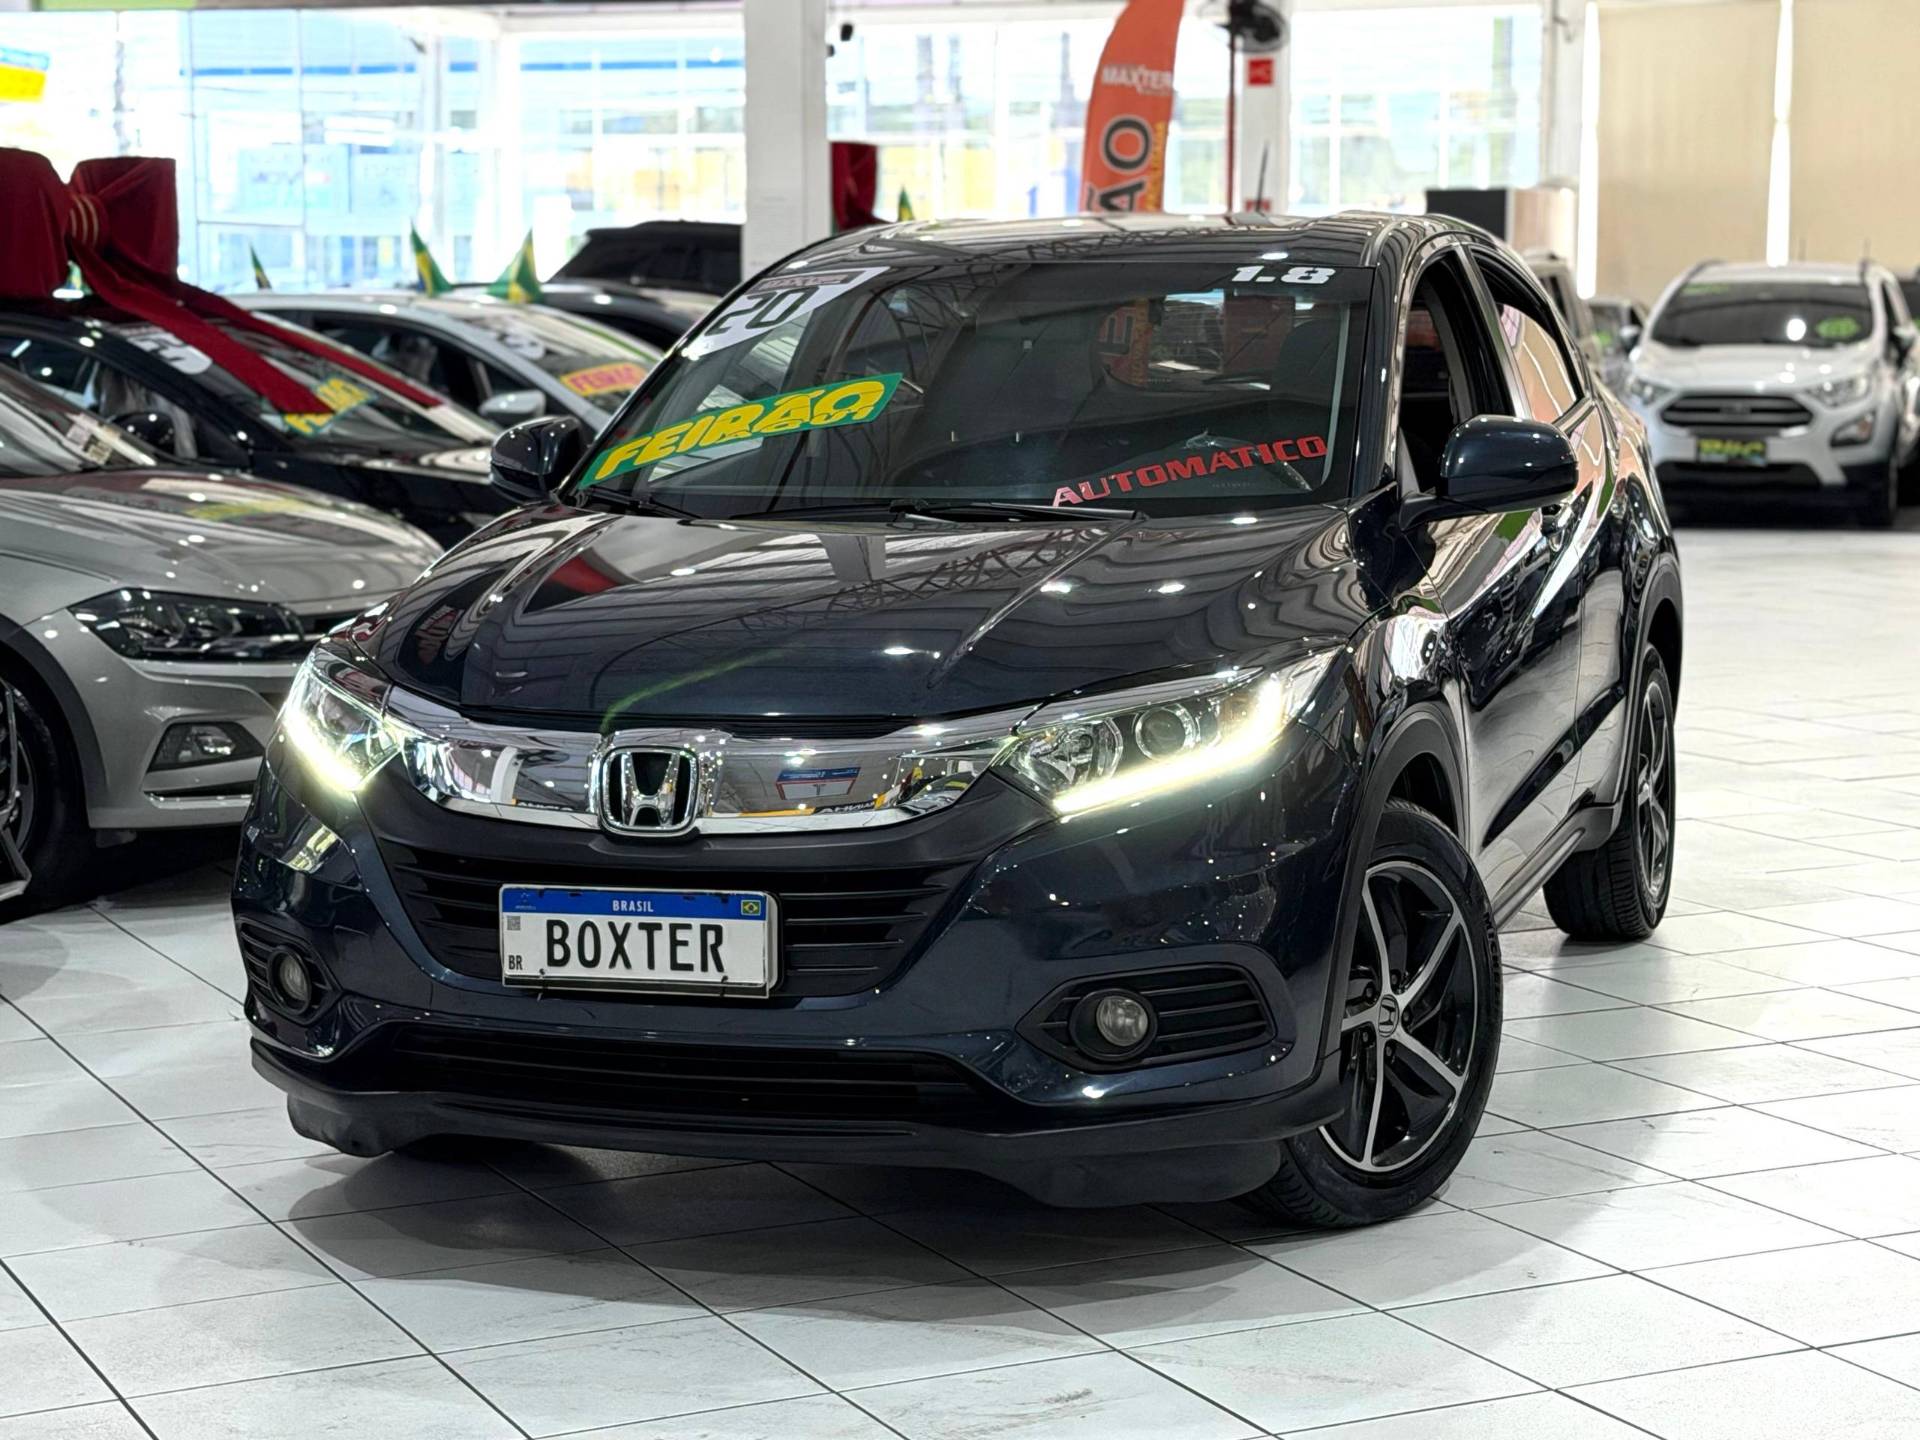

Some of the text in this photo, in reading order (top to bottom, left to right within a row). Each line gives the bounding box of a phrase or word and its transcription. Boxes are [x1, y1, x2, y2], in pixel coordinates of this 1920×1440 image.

[1231, 266, 1336, 284] 1.8
[595, 380, 885, 480] FEIRÃO
[1052, 435, 1328, 507] AUTOMATICO
[612, 899, 654, 912] BRASIL
[508, 955, 523, 970] BR
[546, 919, 725, 973] BOXTER
